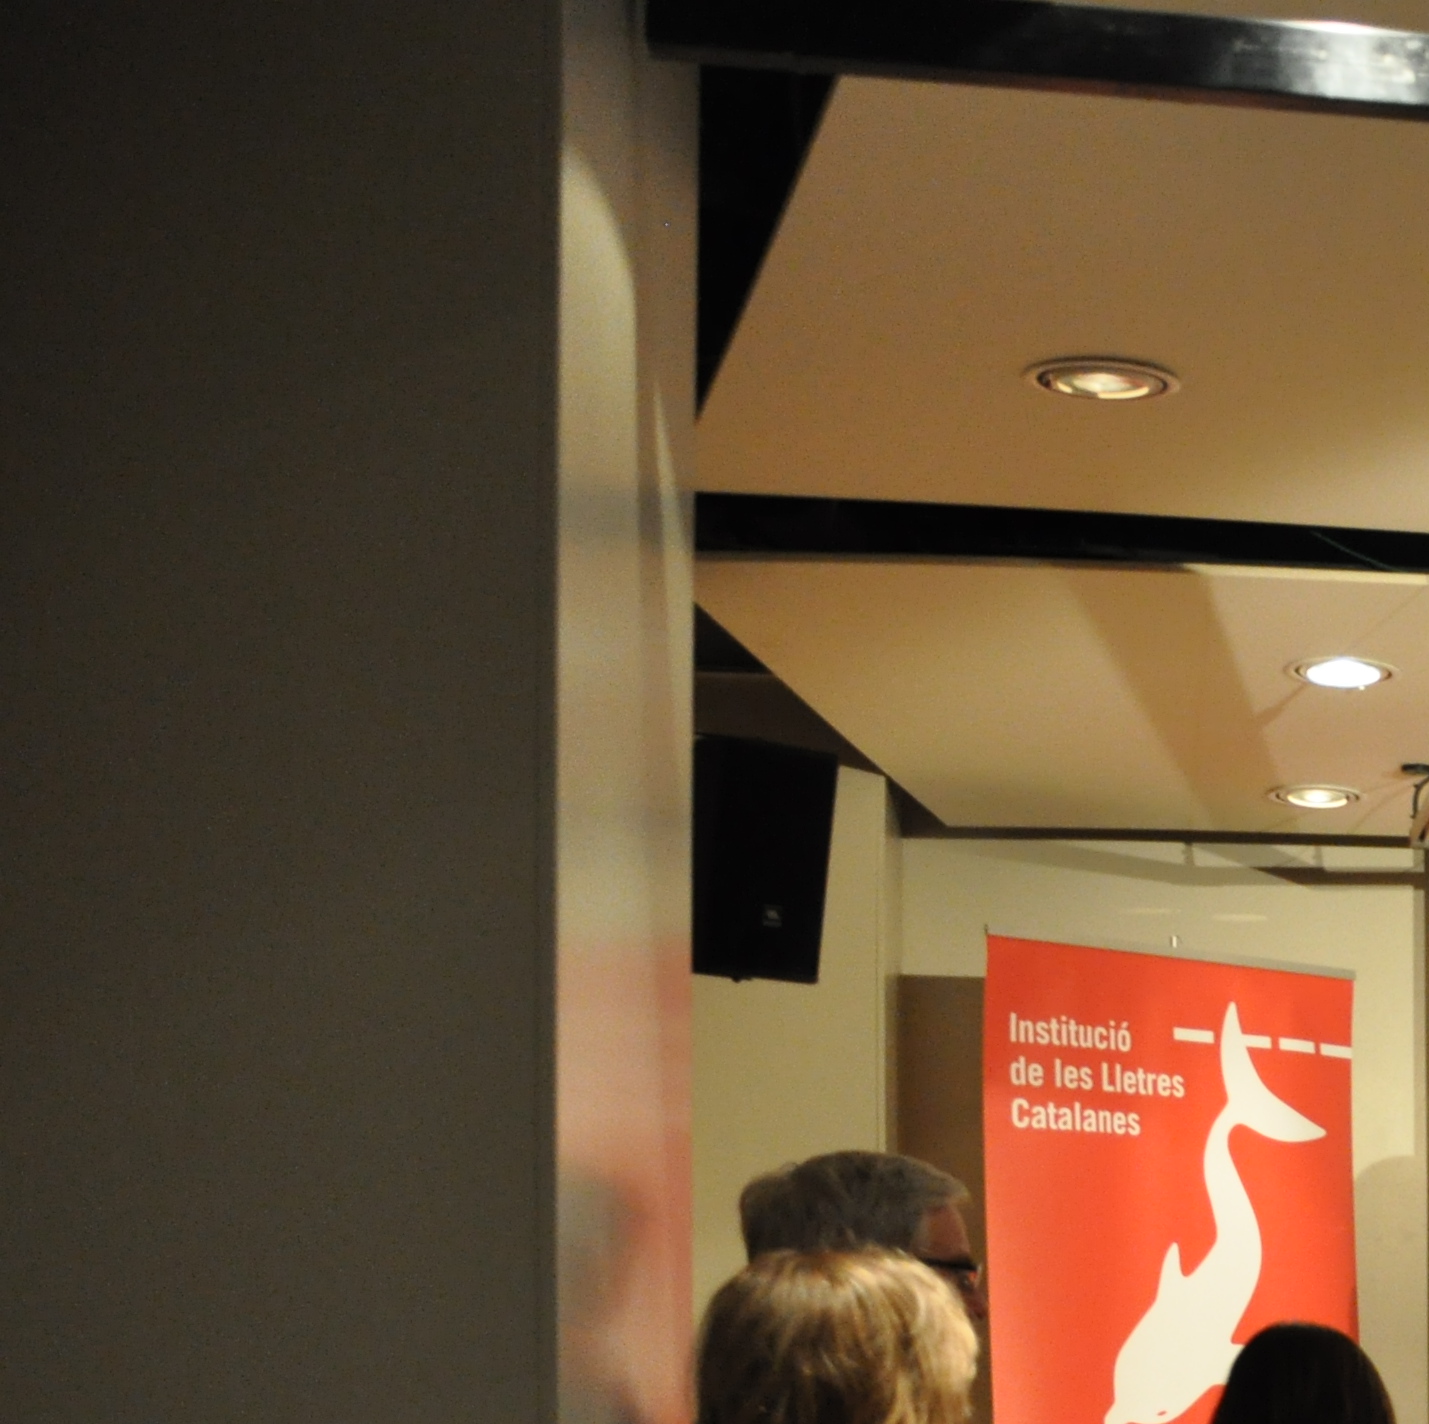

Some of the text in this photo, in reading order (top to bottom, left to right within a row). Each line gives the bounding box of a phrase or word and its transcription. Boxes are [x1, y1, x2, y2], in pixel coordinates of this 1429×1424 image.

[1010, 1012, 1131, 1052] Institució
[1010, 1056, 1185, 1098] de les Lletres
[1011, 1099, 1140, 1136] Catalanes
